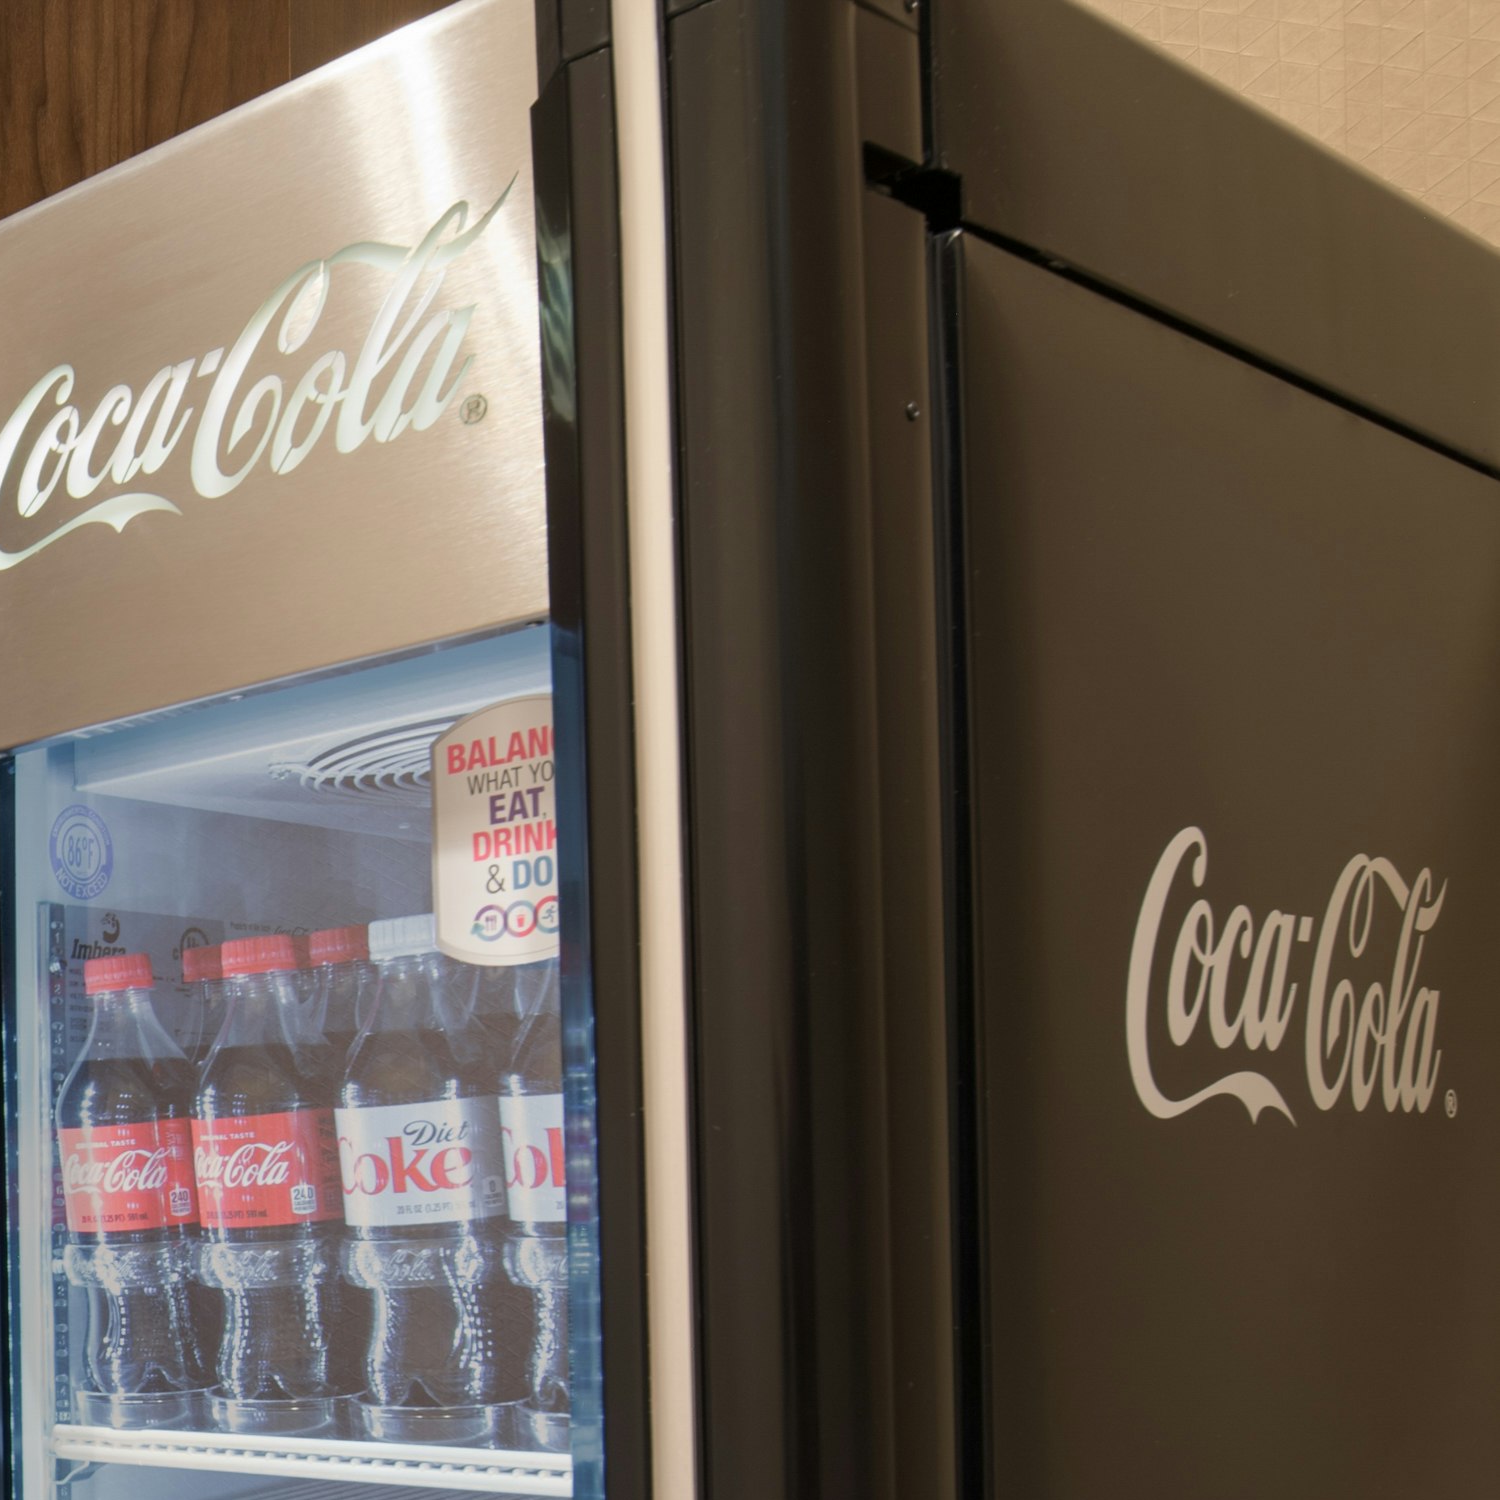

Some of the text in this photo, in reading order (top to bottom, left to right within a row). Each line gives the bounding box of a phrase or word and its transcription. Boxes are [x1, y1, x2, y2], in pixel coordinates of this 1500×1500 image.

[447, 725, 554, 775] BALAN
[467, 760, 555, 796] WHAT YO
[489, 787, 547, 825] EAT,
[56, 868, 108, 898] NOT EXCEED
[485, 855, 554, 894] & DO
[1126, 826, 1448, 1127] Coca-Cola
[111, 1138, 136, 1147] TASTE
[230, 1131, 255, 1140] TASTE
[403, 1120, 469, 1146] Diet
[65, 1147, 171, 1195] Coca-Cola
[339, 1136, 474, 1196] Coke
[502, 1126, 566, 1189] Co
[171, 1190, 188, 1203] 240
